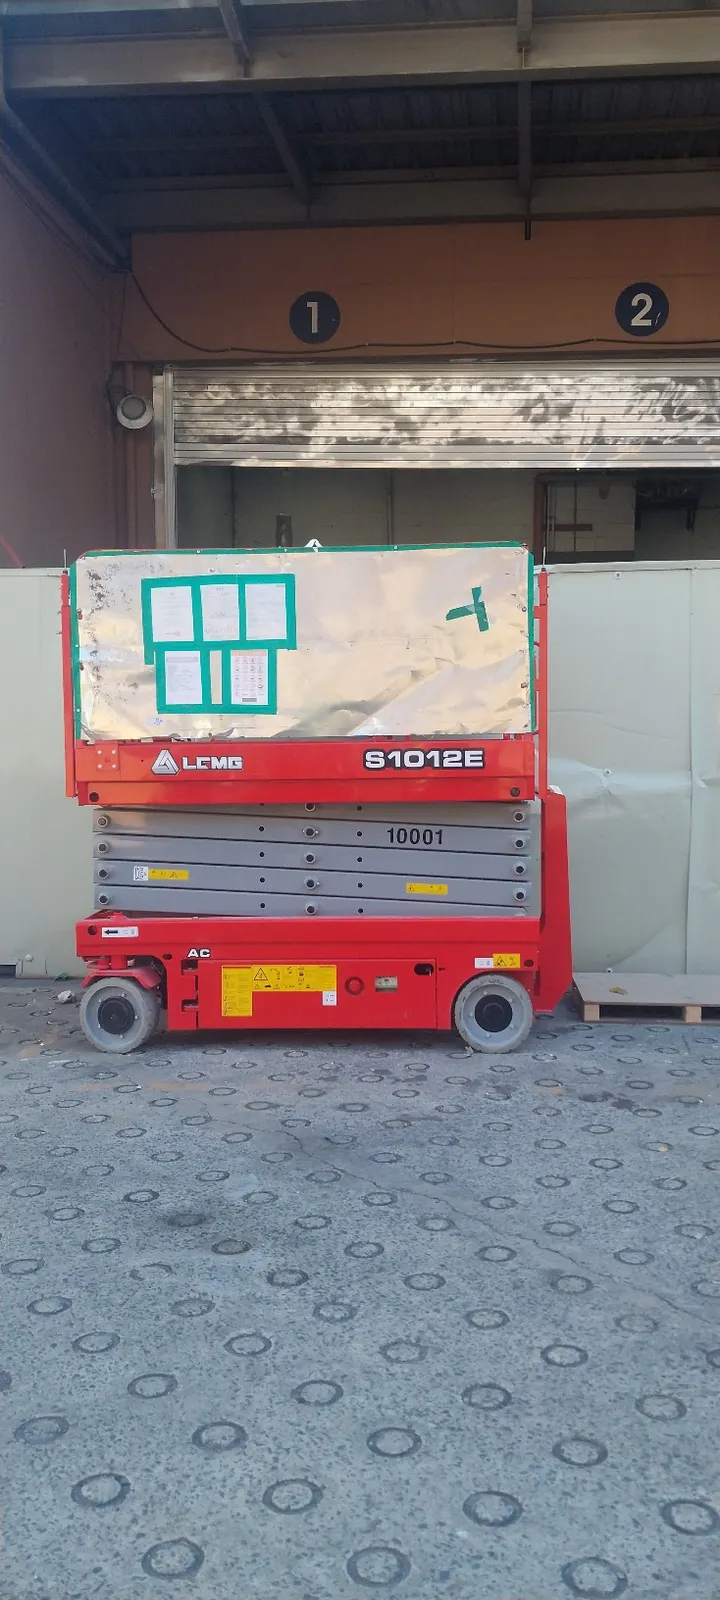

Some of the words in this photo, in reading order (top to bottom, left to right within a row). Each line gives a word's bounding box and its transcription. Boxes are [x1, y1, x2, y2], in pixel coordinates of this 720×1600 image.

[306, 301, 318, 333] 1
[631, 293, 652, 326] 2
[364, 749, 484, 769] S1012E
[387, 827, 443, 845] 10001
[187, 948, 211, 958] AC
